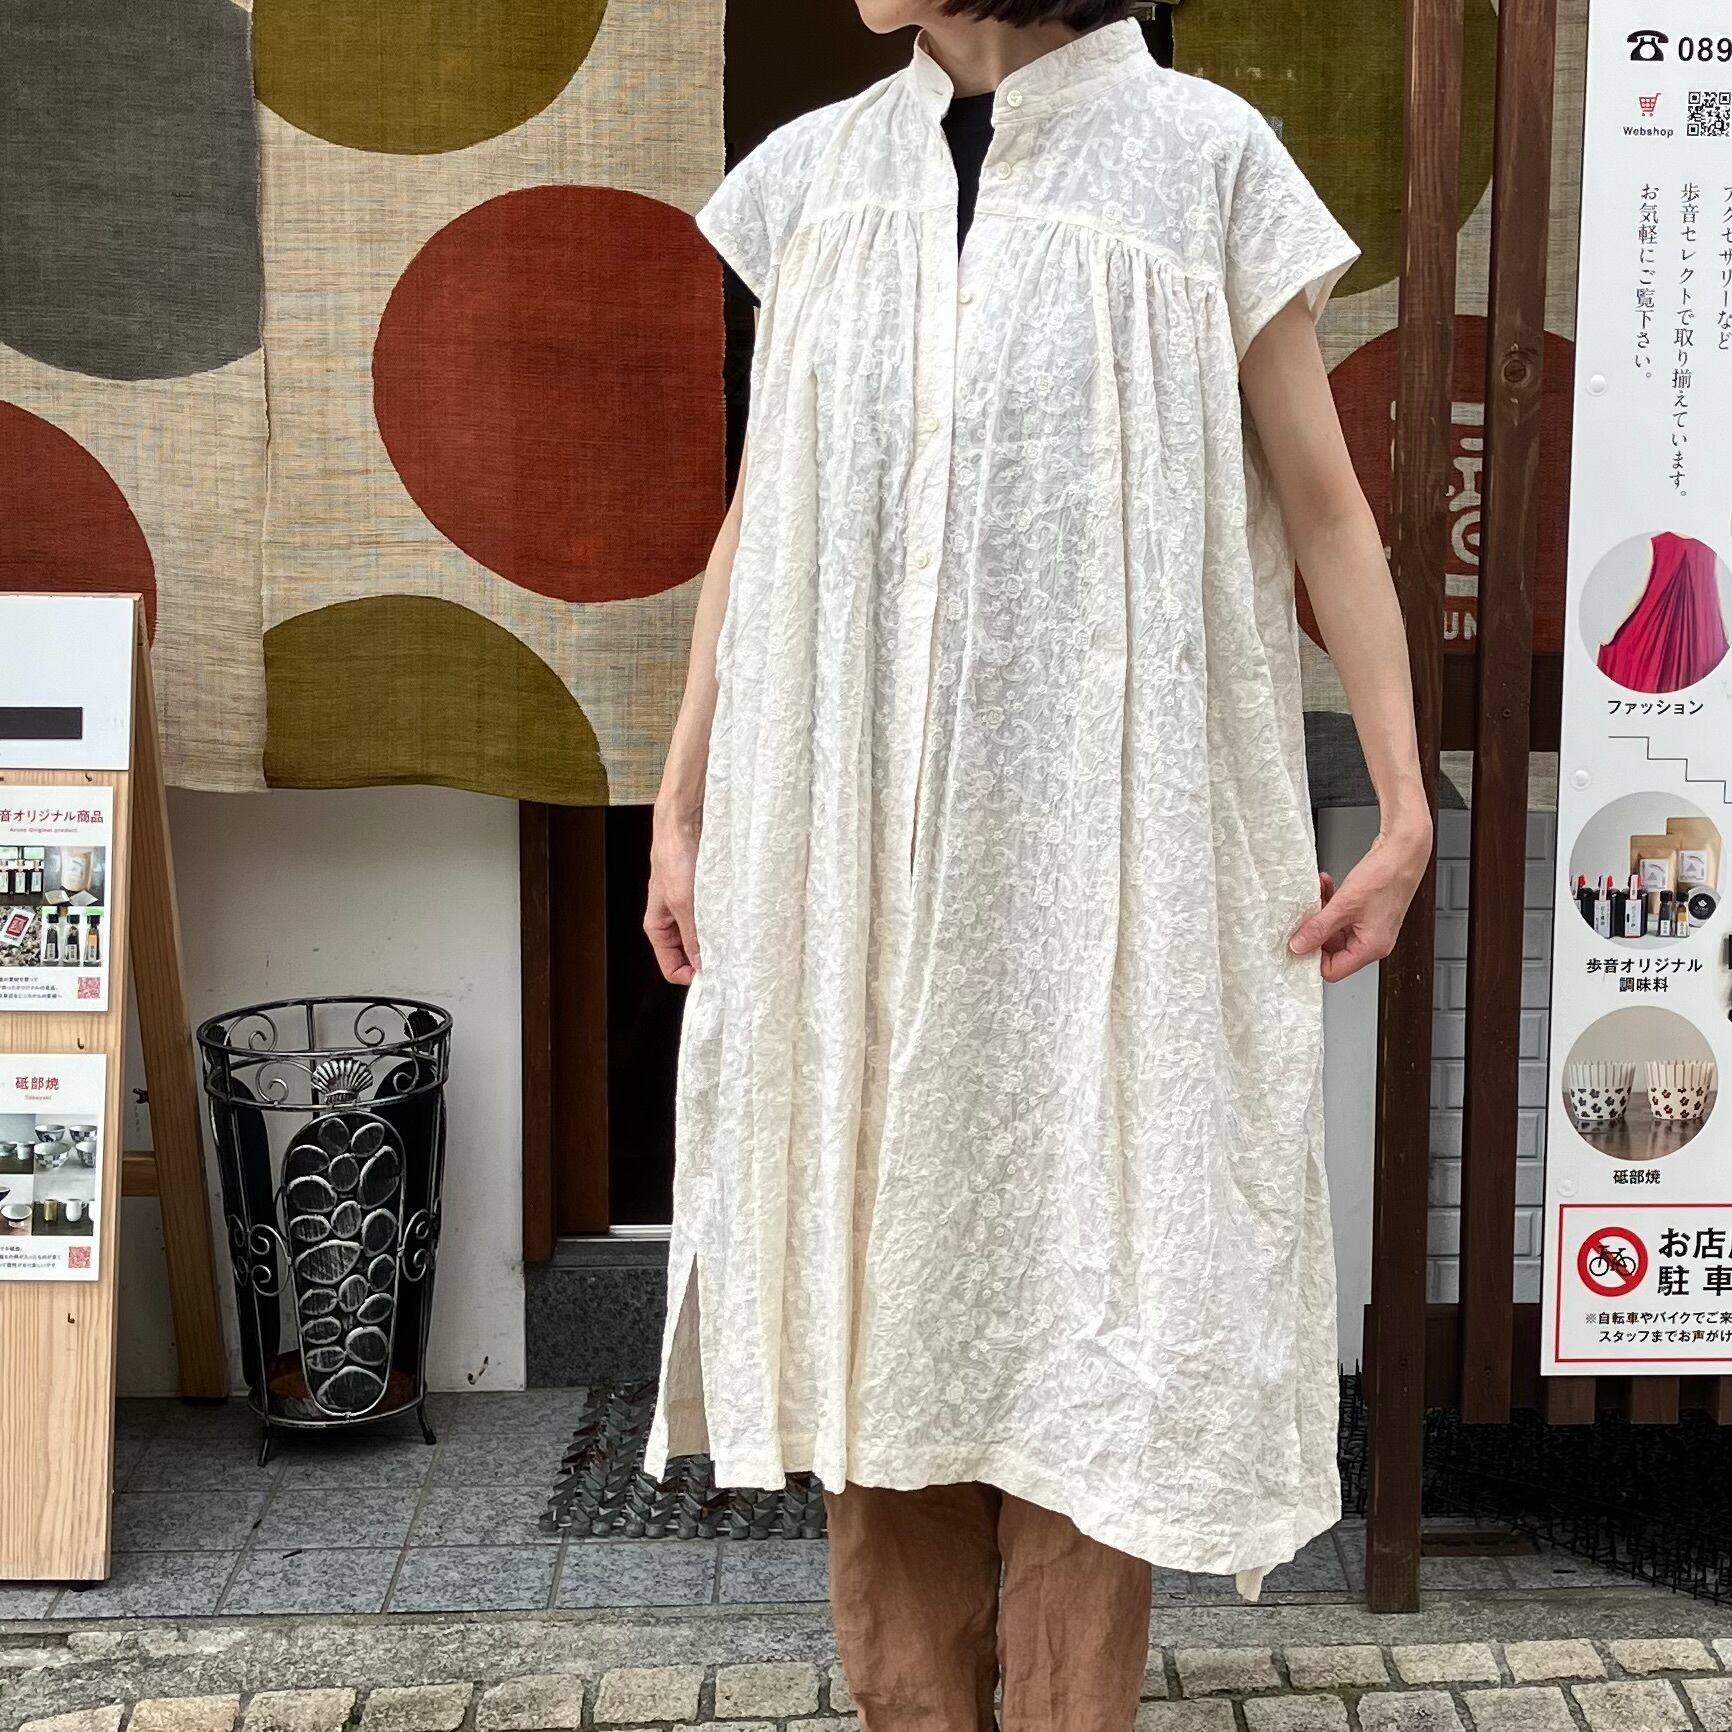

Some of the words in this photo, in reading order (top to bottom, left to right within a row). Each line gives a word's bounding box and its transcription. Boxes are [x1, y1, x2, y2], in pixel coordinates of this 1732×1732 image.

[1677, 36, 1732, 62] 089
[1622, 126, 1674, 139] Webshop
[1634, 183, 1660, 379] お気軽にご覧下さい。
[1668, 181, 1701, 497] 歩音セレクトで取り揃えています。
[1607, 699, 1704, 716] ファッション
[0, 808, 104, 824] 音オリジナル商品
[1586, 957, 1703, 974] 歩音オリジナル
[1619, 976, 1669, 993] 調味料
[15, 1076, 60, 1091] 砥部焼
[1612, 1168, 1662, 1185] 砥部焼
[1657, 1227, 1732, 1260] お店
